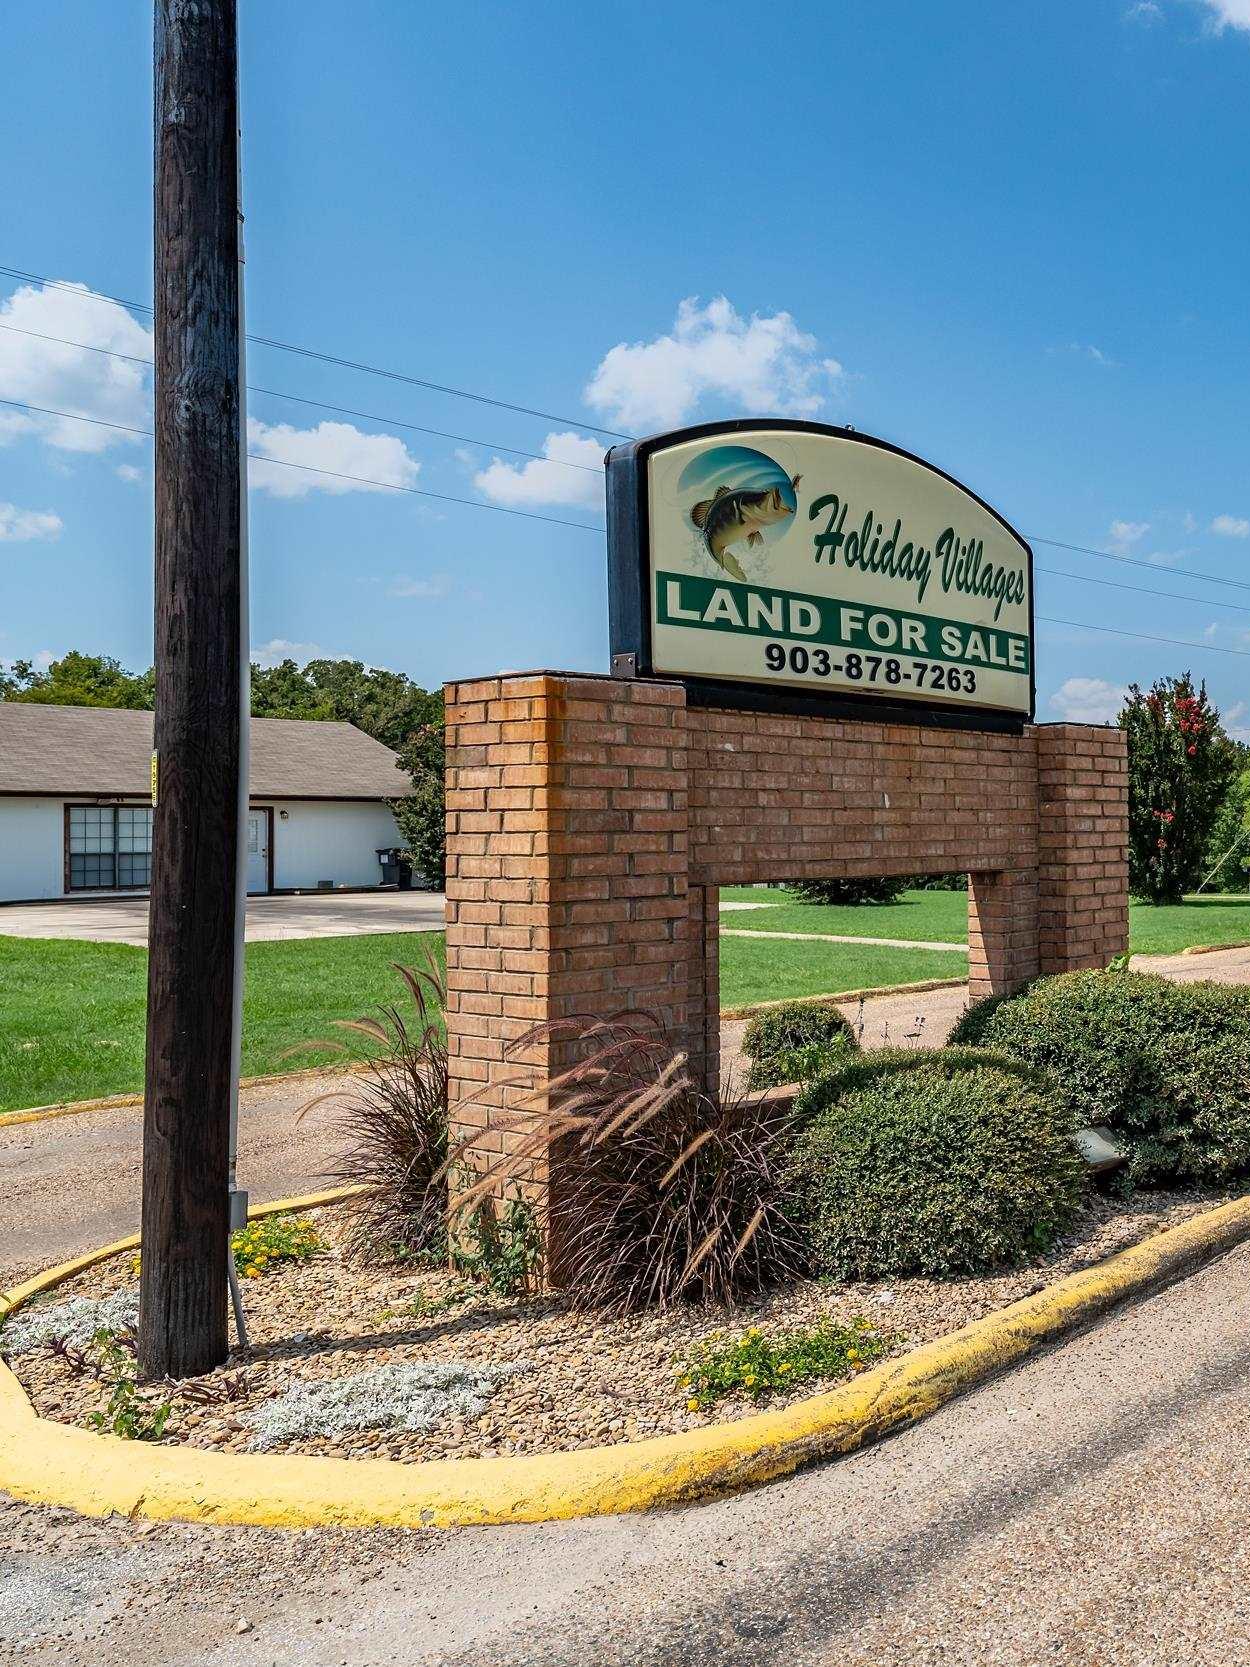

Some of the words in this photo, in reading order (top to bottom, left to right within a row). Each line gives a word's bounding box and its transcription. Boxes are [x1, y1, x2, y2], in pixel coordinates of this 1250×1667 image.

[809, 494, 931, 603] Holiday
[935, 526, 1025, 622] Villages
[665, 580, 821, 636] LAND
[840, 608, 929, 653] FOR
[940, 626, 1026, 669] SALE
[765, 643, 977, 694] 903-878-7263
